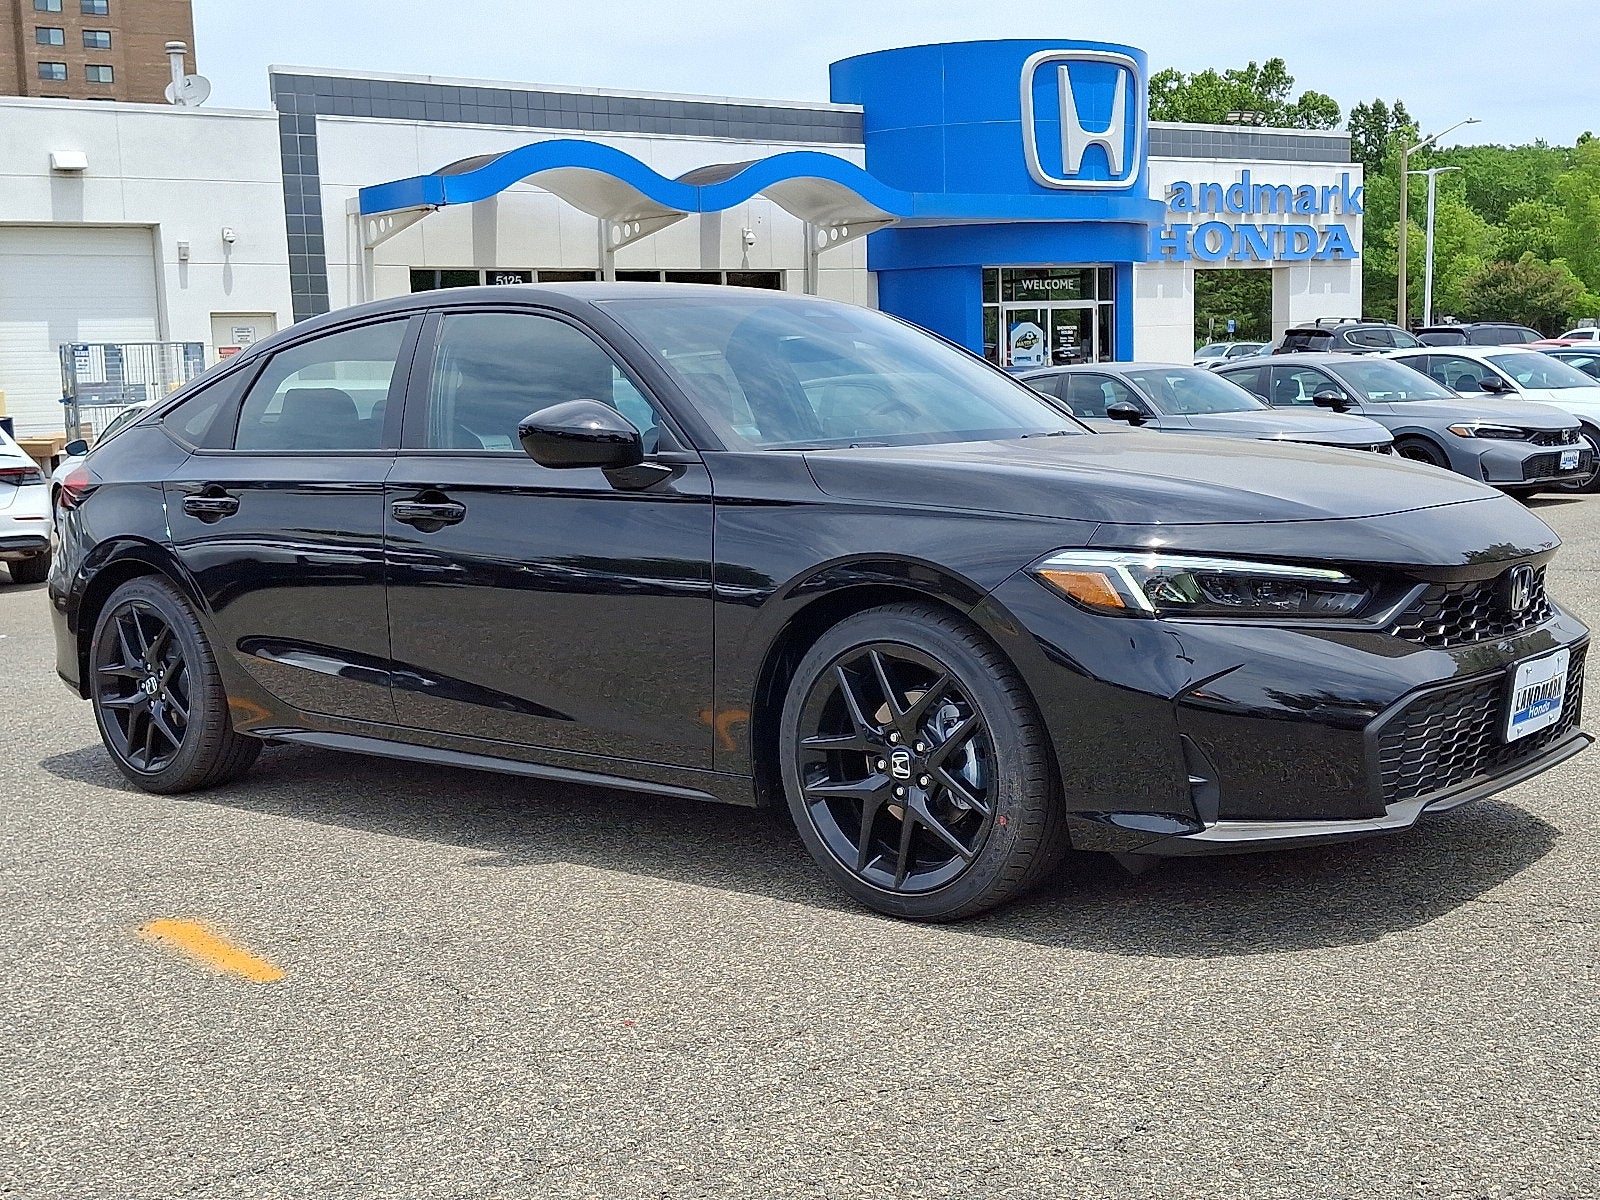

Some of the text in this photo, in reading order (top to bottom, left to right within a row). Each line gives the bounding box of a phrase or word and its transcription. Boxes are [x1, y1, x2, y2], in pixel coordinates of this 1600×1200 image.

[1147, 167, 1364, 215] andmark
[1148, 221, 1359, 261] HONDA
[496, 275, 523, 285] 5125
[1021, 279, 1074, 290] WELCOME
[1516, 676, 1562, 711] LANDMARK
[1528, 700, 1551, 719] Honda
